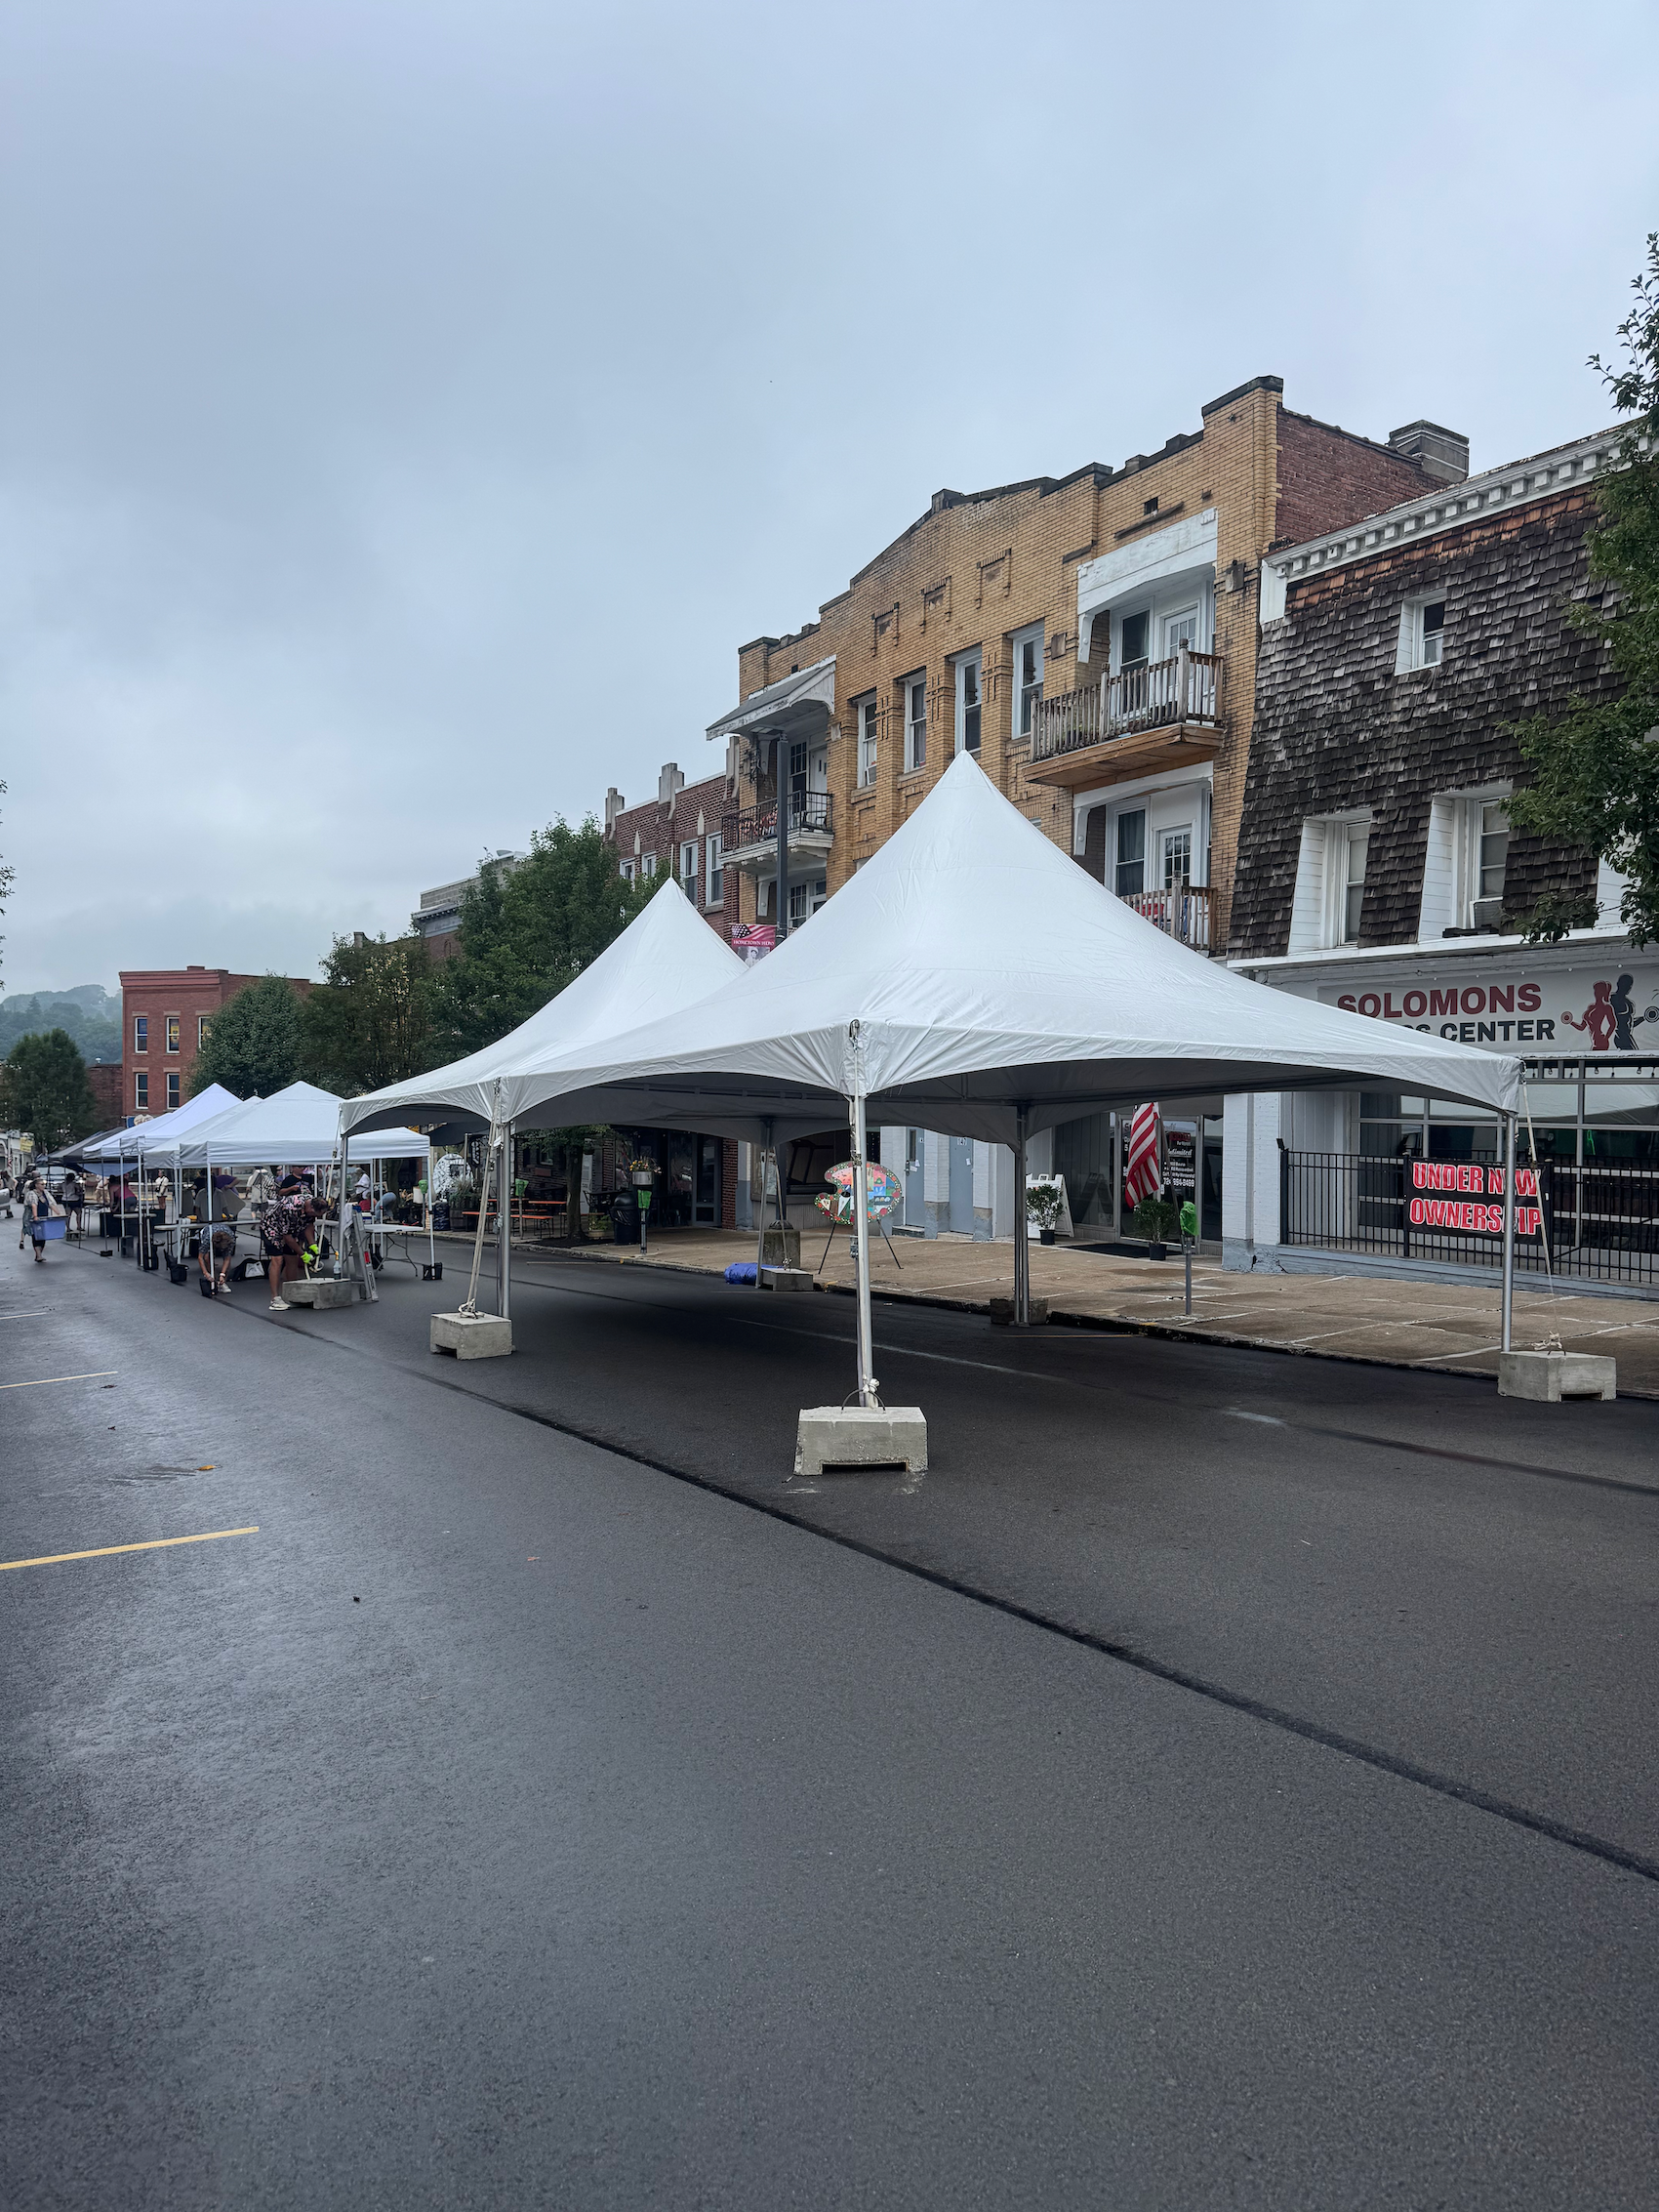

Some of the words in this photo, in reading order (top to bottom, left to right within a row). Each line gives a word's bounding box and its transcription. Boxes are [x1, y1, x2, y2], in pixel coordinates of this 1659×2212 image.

[1337, 983, 1542, 1019] SOLOMONS
[1439, 1019, 1556, 1044] CENTER
[1412, 1161, 1483, 1194] UNDER
[1487, 1167, 1541, 1197] NW
